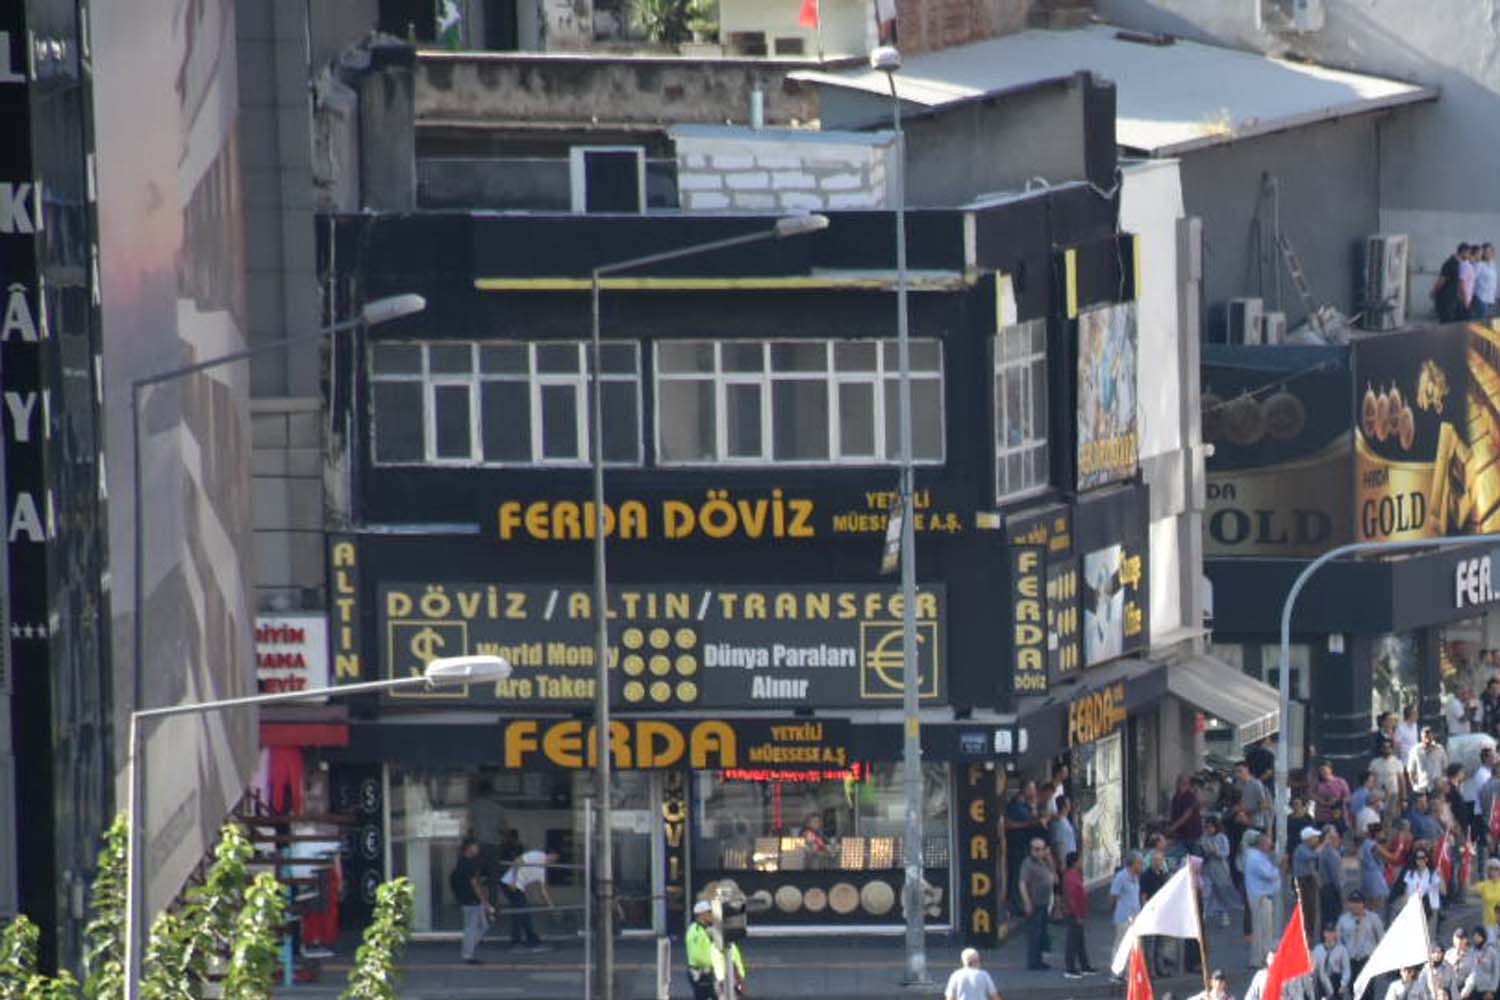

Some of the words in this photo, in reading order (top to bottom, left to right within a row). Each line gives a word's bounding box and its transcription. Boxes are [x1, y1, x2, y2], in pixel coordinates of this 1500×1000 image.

[499, 499, 648, 540] FERDA
[662, 488, 815, 539] DÖVİZ
[1208, 508, 1332, 546] OLD
[1362, 491, 1427, 540] GOLD
[332, 541, 361, 678] ALTIN
[386, 585, 527, 619] DÖVİZ
[1015, 551, 1043, 670] FERDA
[547, 642, 620, 669] Mony
[703, 643, 769, 669] Dünya
[773, 643, 857, 668] Paraları
[751, 674, 809, 699] Alınır
[504, 720, 738, 769] FERDA
[969, 765, 993, 935] FERDA
